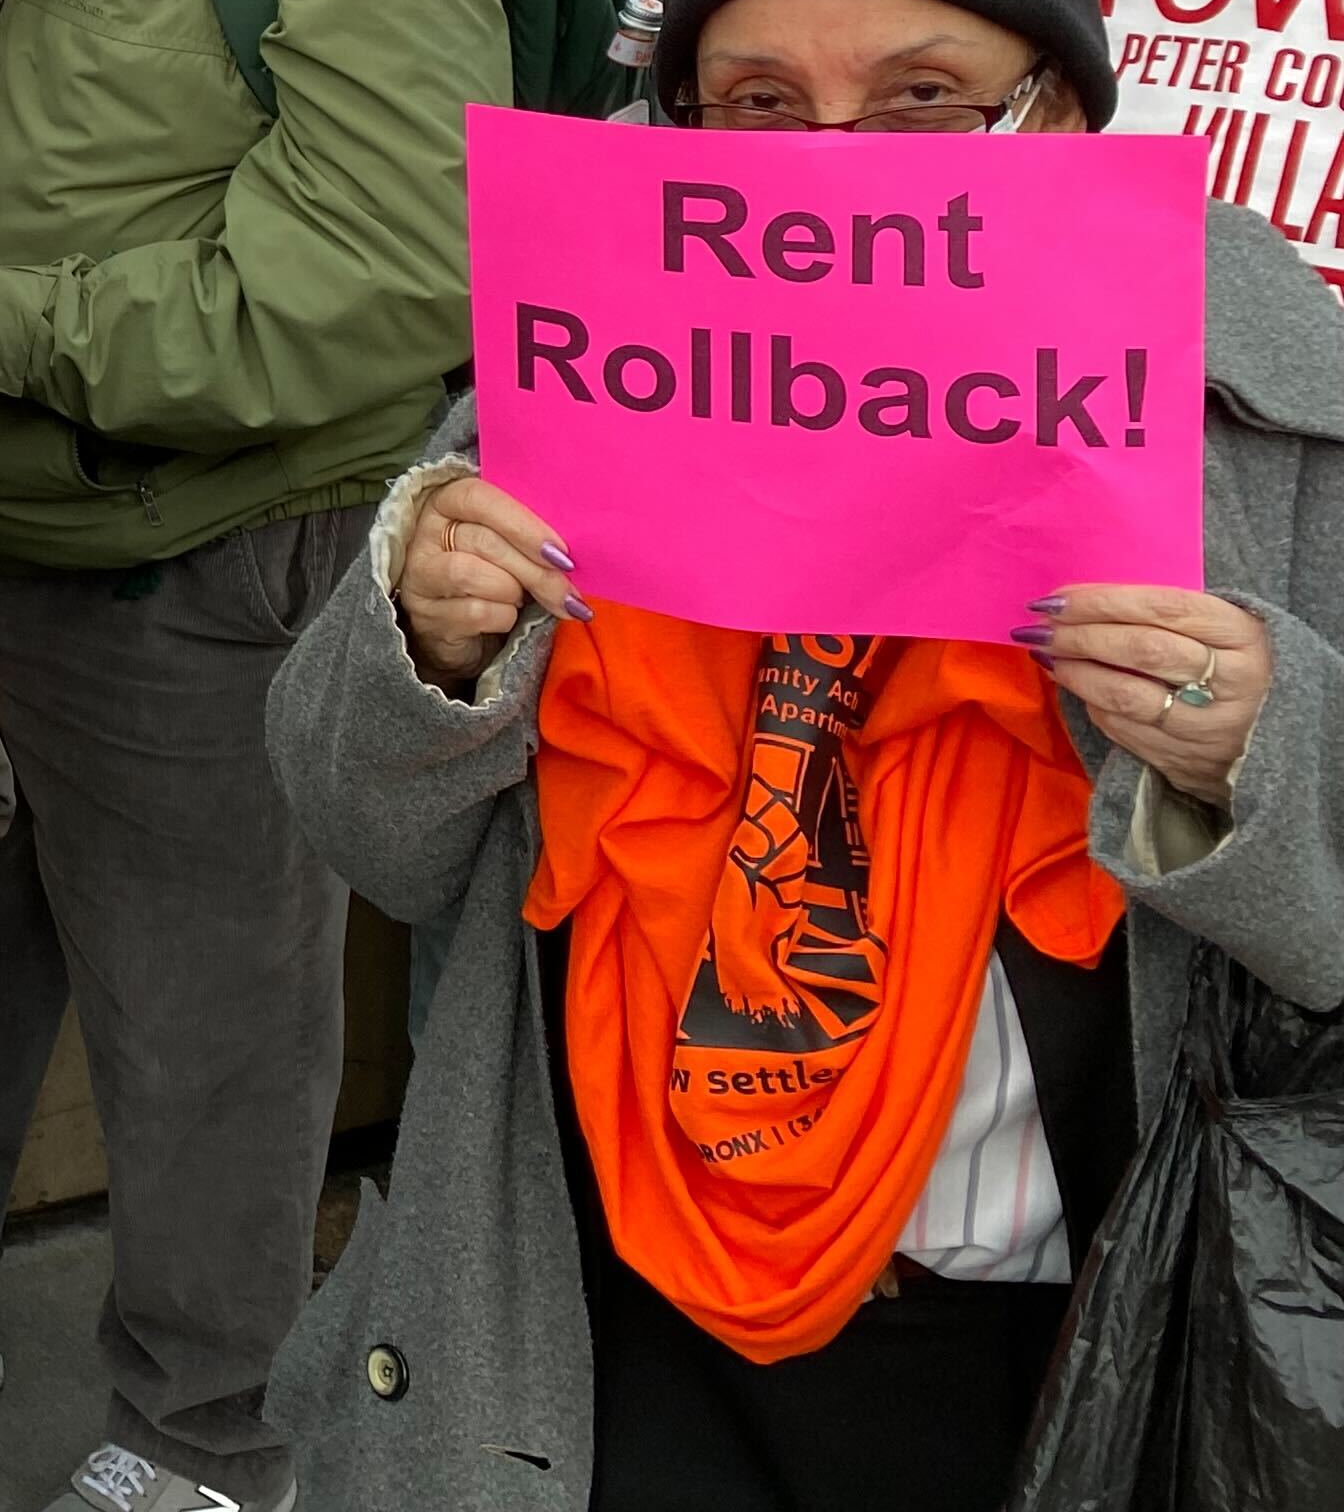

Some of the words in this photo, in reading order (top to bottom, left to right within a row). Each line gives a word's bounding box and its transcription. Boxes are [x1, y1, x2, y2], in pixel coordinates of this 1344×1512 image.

[1114, 33, 1251, 95] PETER
[661, 179, 986, 290] Rent
[515, 300, 1149, 449] Rollback!
